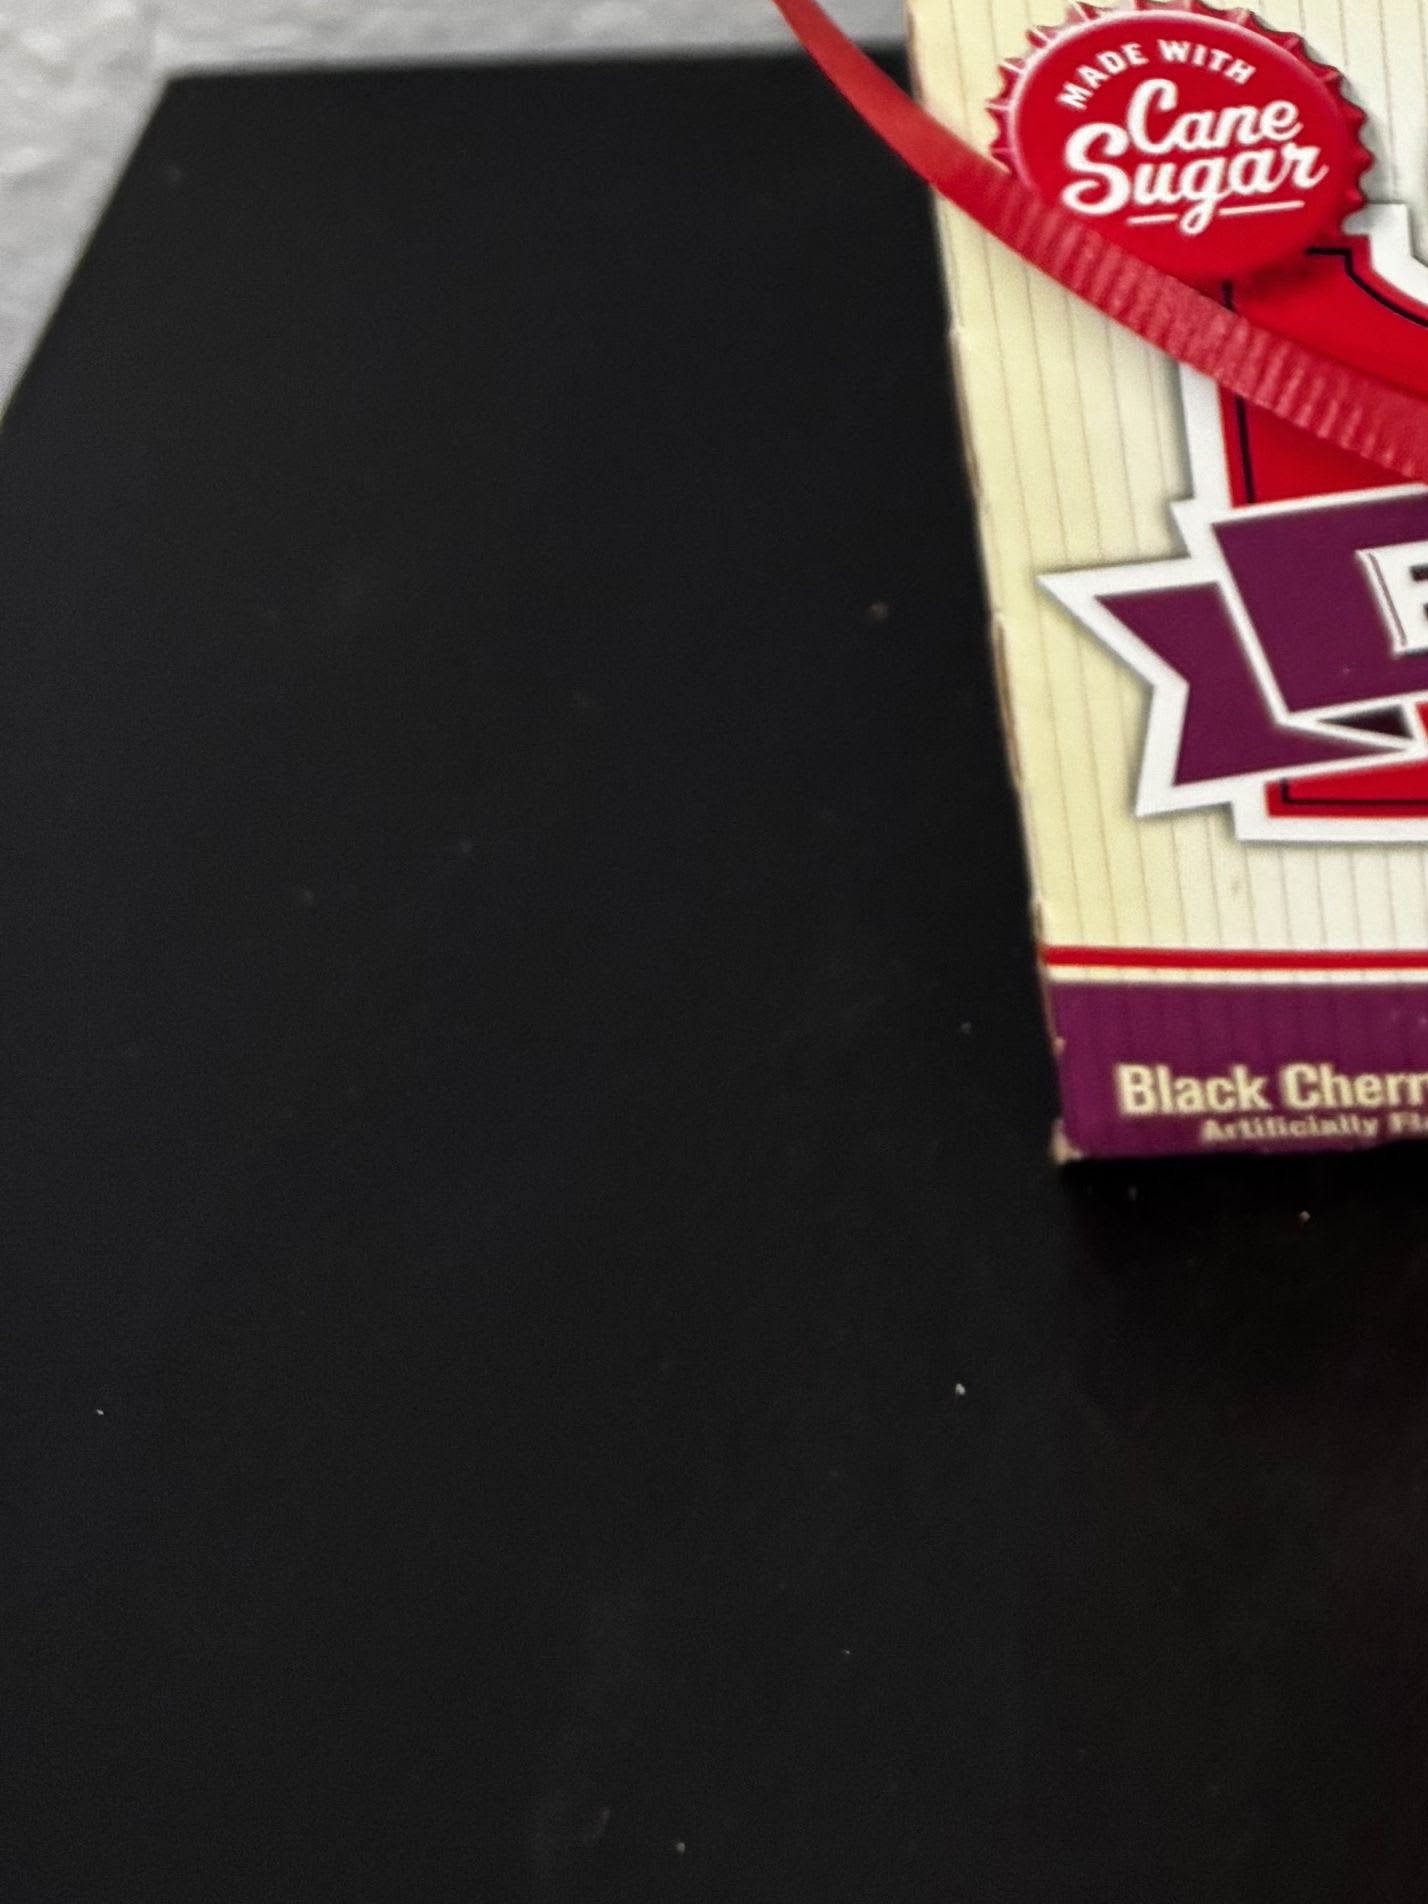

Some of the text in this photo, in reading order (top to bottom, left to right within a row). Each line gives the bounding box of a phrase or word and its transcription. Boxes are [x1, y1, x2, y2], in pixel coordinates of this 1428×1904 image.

[1055, 37, 1257, 112] MADE WITH
[1126, 76, 1305, 155] Cane
[1060, 121, 1330, 236] Sugar
[1114, 1062, 1272, 1117] Black
[1200, 1111, 1380, 1143] Artificially
